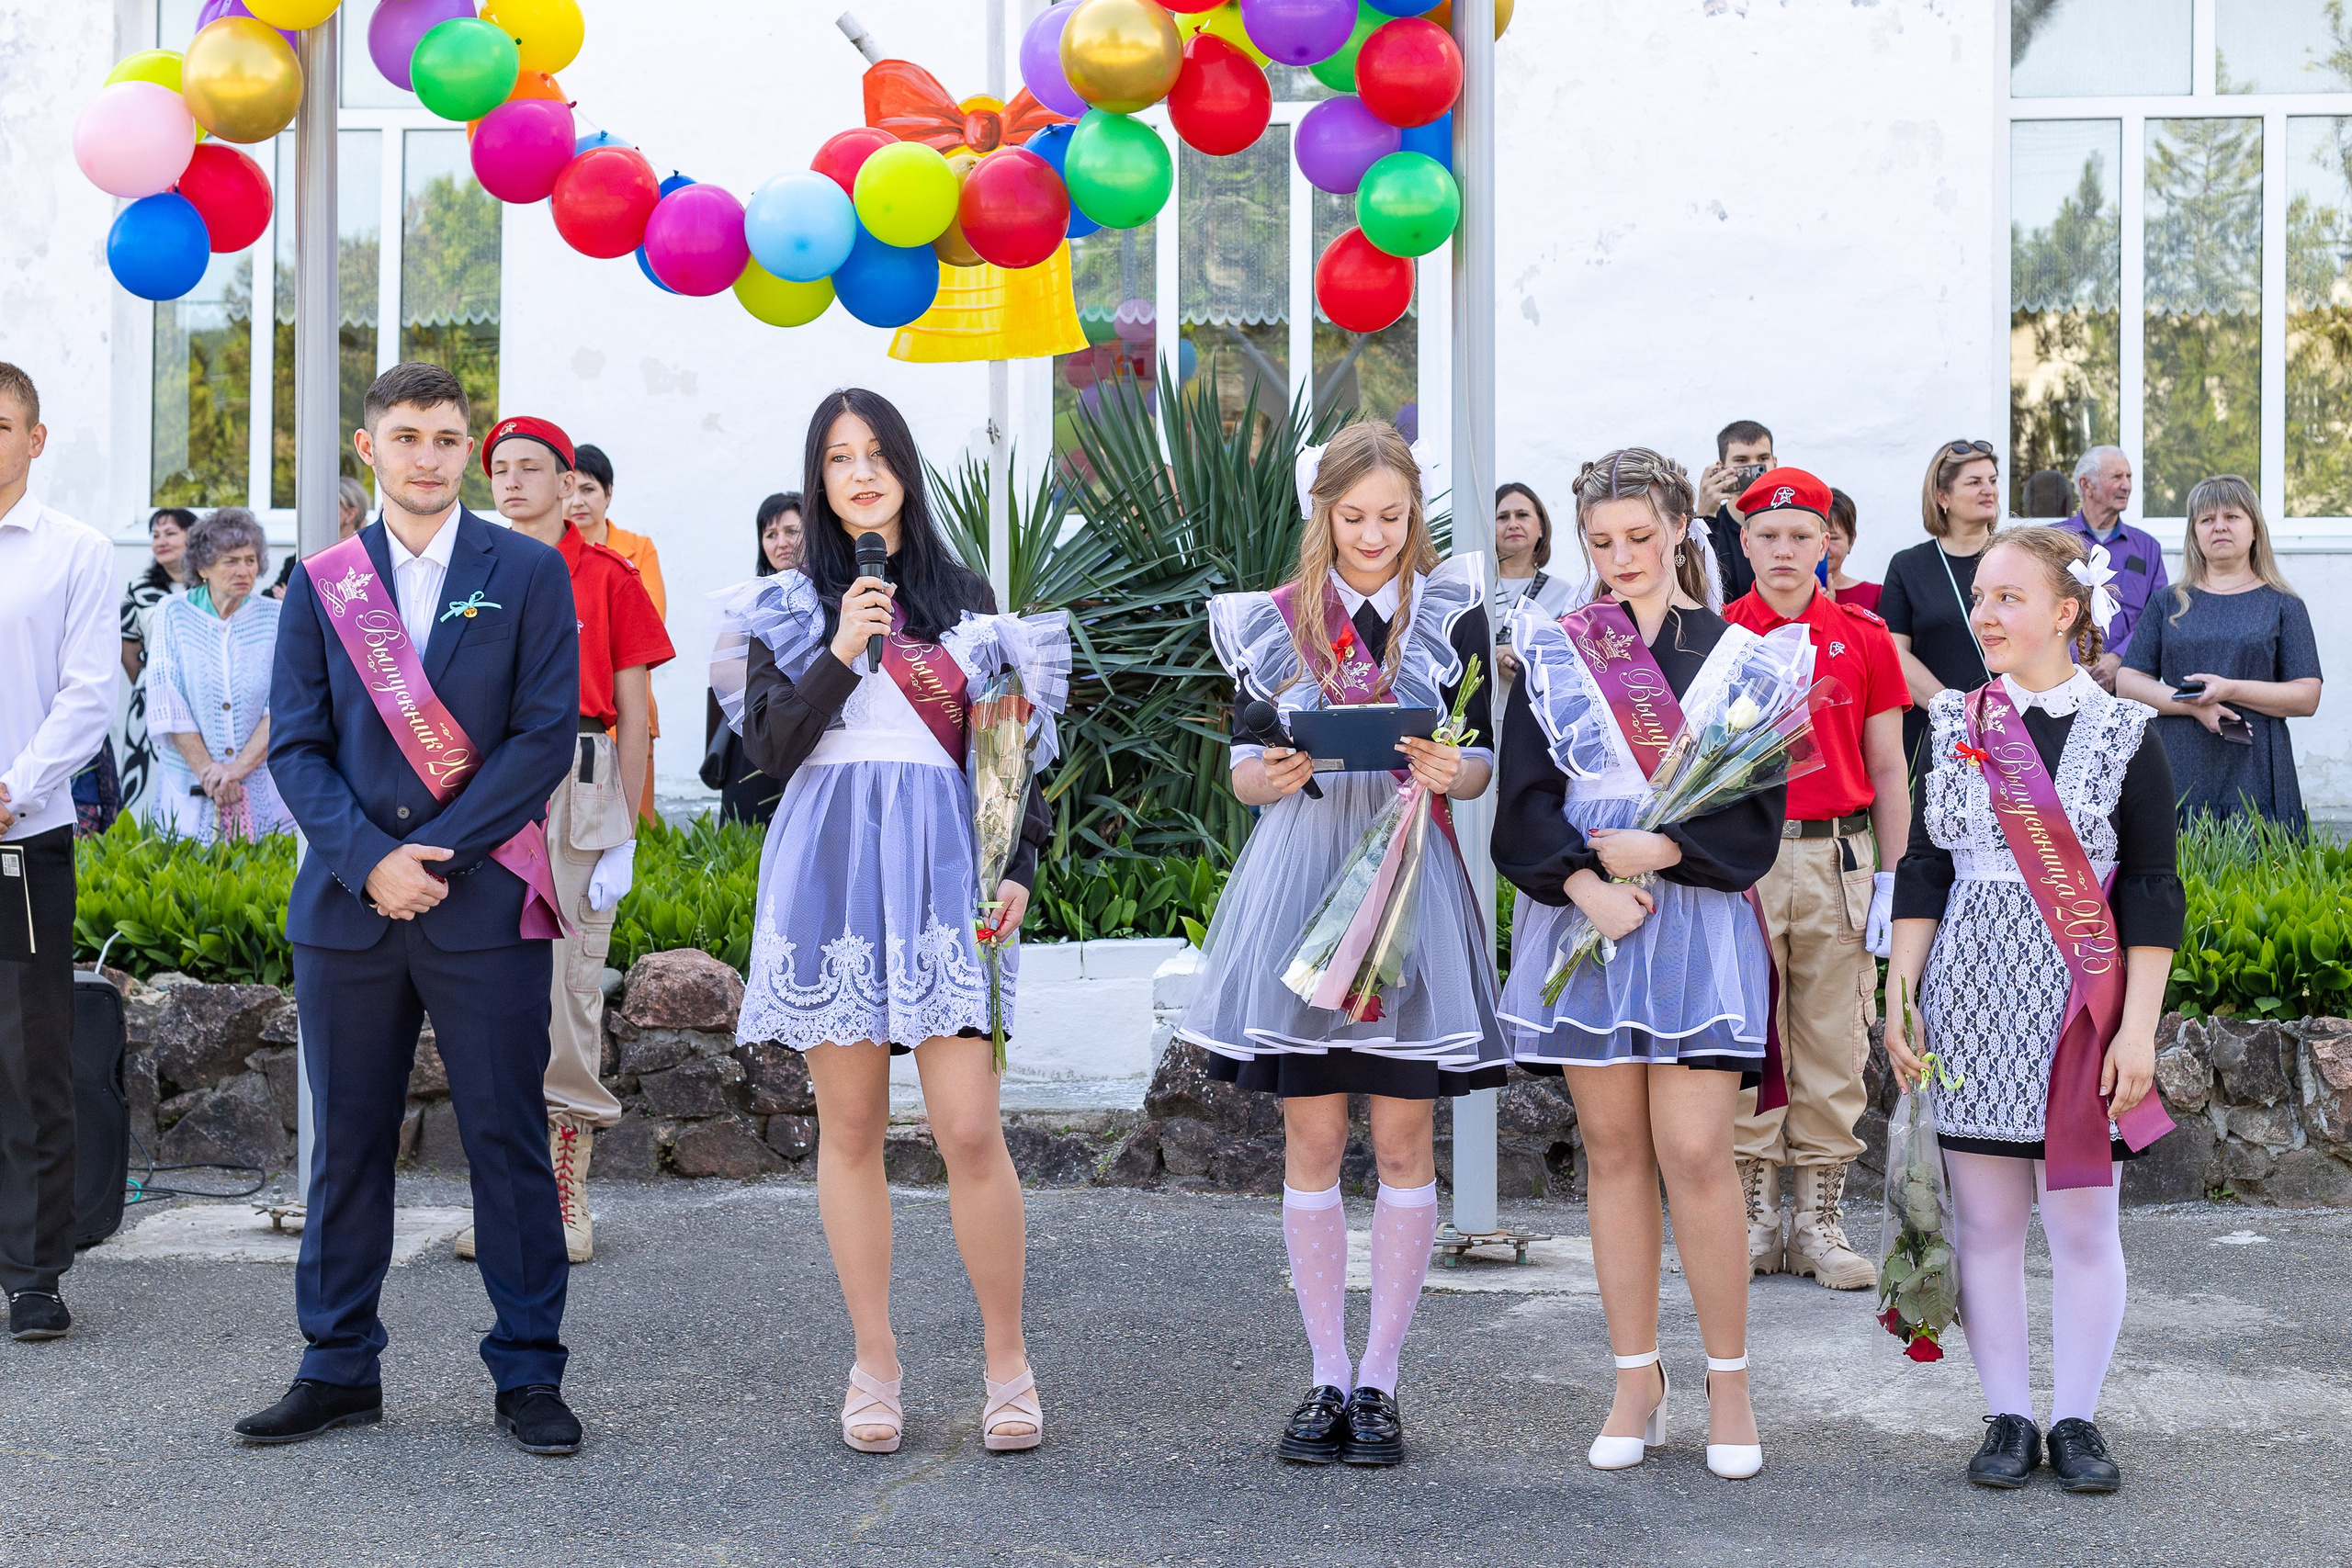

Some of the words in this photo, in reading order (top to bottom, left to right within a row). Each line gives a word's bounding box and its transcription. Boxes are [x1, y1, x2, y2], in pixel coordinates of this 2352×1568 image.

[356, 610, 444, 753] Выпускник
[424, 748, 478, 788] 20
[1991, 741, 2076, 900] Выпускница
[2052, 899, 2121, 975] 2025
